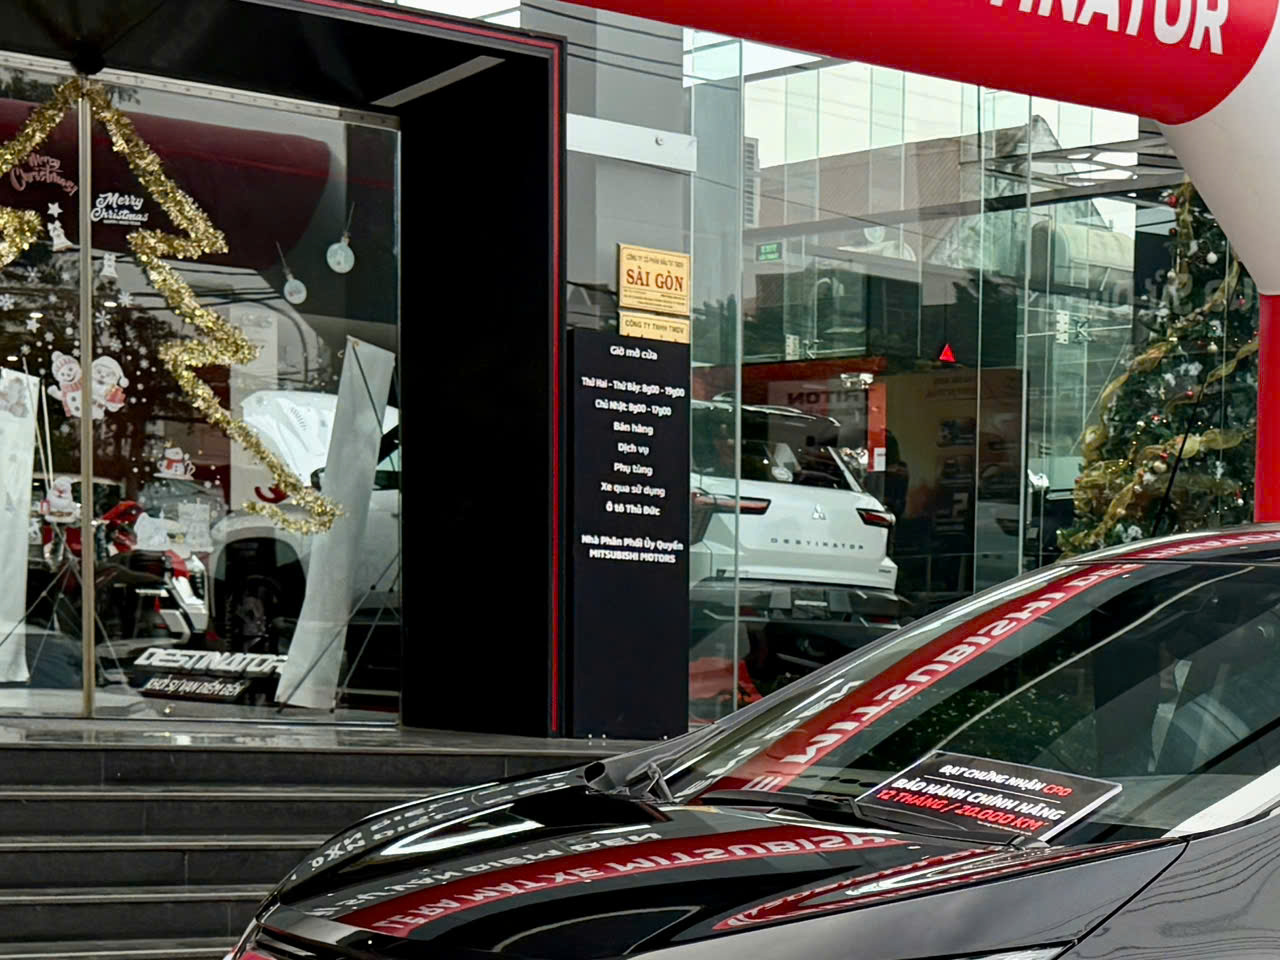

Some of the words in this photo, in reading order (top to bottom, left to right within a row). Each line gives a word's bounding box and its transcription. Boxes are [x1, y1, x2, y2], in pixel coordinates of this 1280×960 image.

[96, 192, 143, 210] Merry
[91, 207, 149, 221] Christmas
[626, 265, 650, 287] SÀI
[655, 270, 684, 292] GÒN
[610, 345, 625, 356] Giờ
[613, 421, 631, 432] Bán
[631, 423, 654, 436] hàng
[617, 442, 637, 454] Dịch
[638, 445, 650, 456] vụ
[613, 462, 631, 474] Phụ
[632, 464, 654, 477] tùng
[600, 481, 612, 492] Xe
[613, 484, 630, 494] qua
[631, 483, 643, 494] sử
[643, 485, 666, 498] dụng
[605, 500, 613, 512] Ô
[614, 503, 625, 513] tô
[625, 503, 642, 514] Thủ
[643, 505, 661, 516] Đức
[589, 548, 639, 561] MITSUBISHI
[640, 553, 677, 564] MOTORS
[938, 764, 965, 778] ĐẠT
[963, 768, 1009, 785] CHỨNG
[1005, 774, 1046, 792] NHẬN
[1041, 783, 1073, 798] CPO
[876, 788, 894, 802] 12
[893, 790, 949, 811] THÁNG
[955, 804, 1013, 824] 20.000
[891, 777, 923, 791] BẢO
[921, 783, 970, 799] HÀNH
[966, 790, 1020, 810] CHÍNH
[1014, 799, 1066, 821] HÃNG
